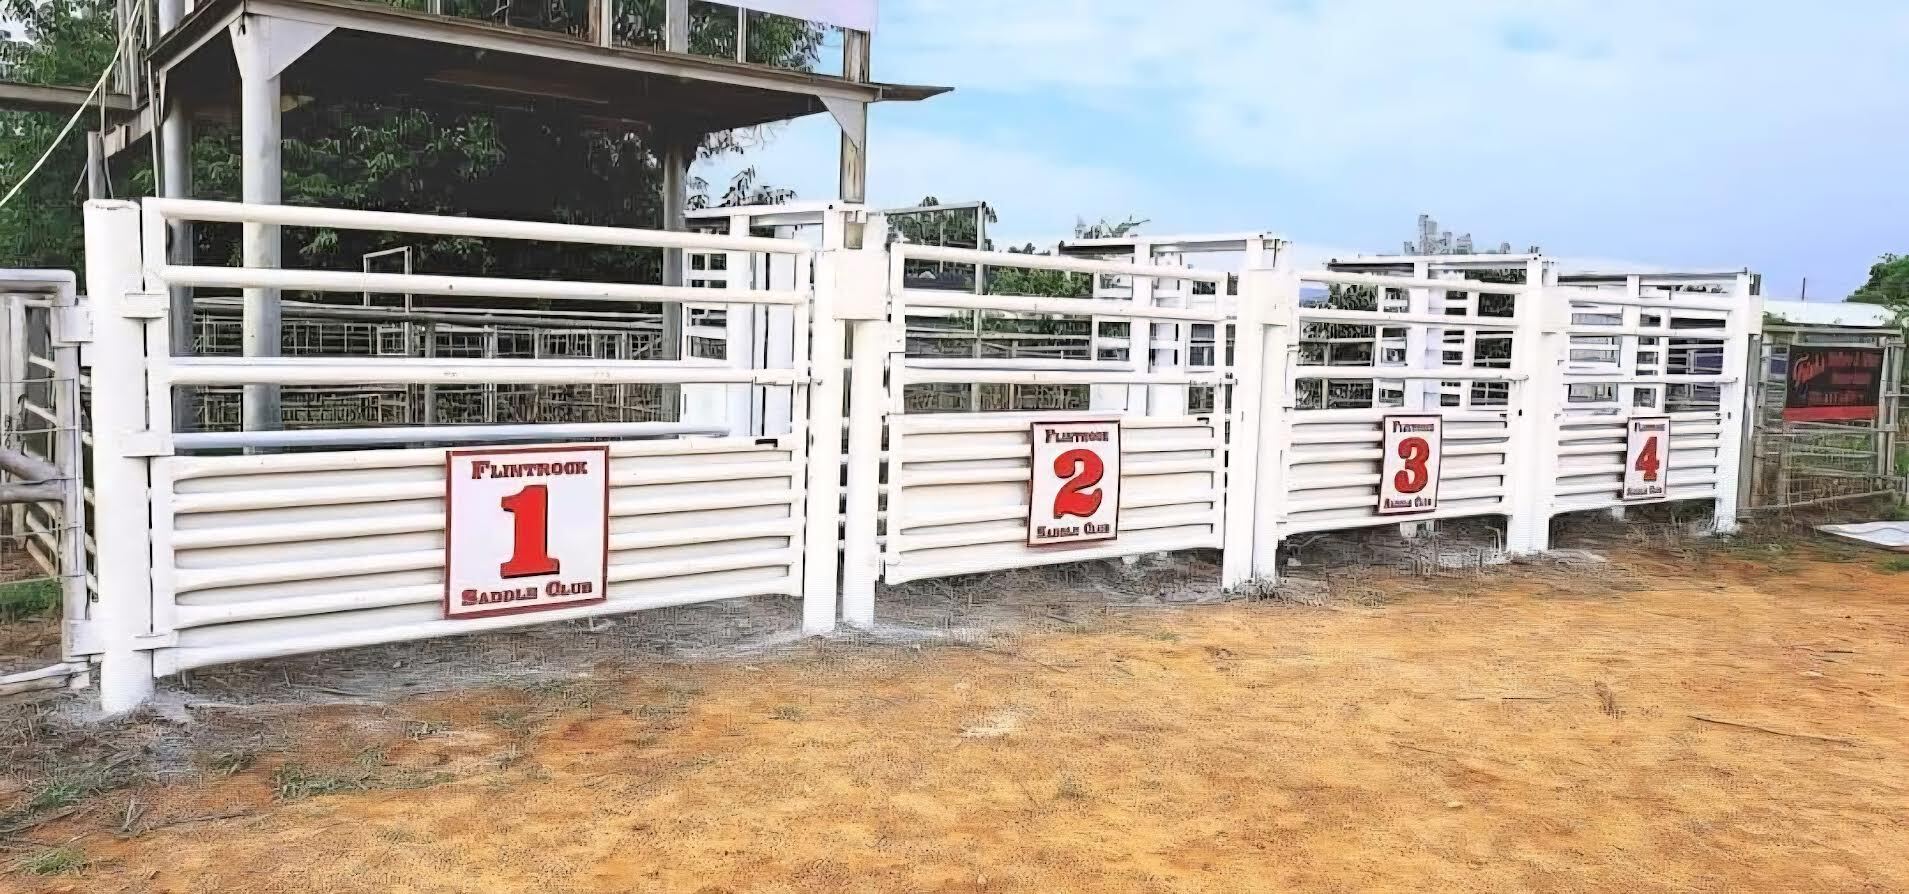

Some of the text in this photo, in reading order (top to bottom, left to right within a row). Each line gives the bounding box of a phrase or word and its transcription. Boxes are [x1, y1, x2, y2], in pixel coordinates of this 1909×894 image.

[1054, 448, 1104, 519] 2
[1394, 436, 1430, 494] 3
[1635, 436, 1660, 482] 4
[500, 484, 560, 579] 1
